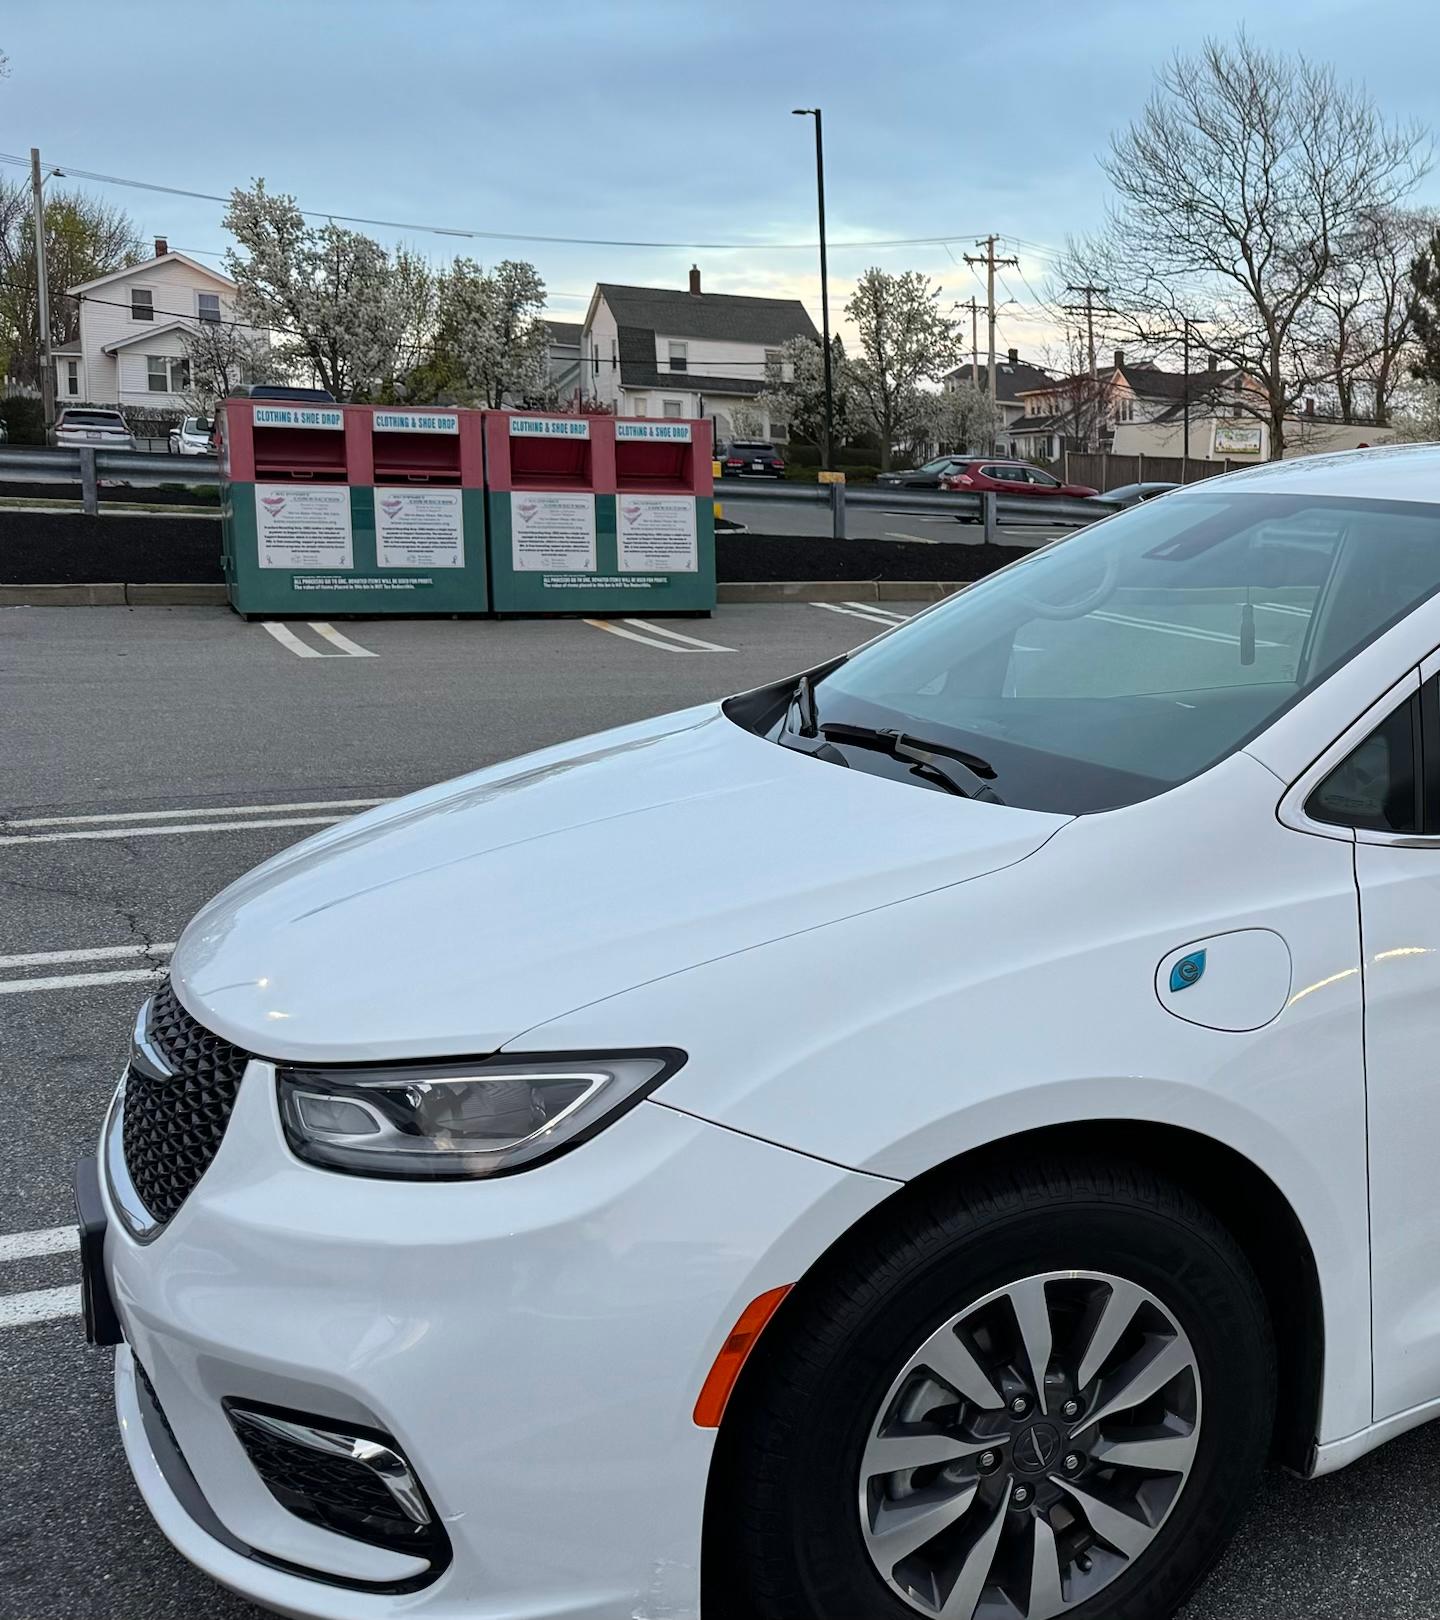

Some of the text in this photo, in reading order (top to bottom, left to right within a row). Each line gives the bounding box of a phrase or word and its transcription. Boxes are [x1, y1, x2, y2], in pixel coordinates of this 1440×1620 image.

[257, 410, 340, 424] CLOTHING & SHOE DROP
[377, 416, 455, 429] CLOTHING & SHOE DROP
[513, 421, 586, 434] CLOTHING & SHOE DROP
[618, 426, 688, 438] CLOTHING & SHOE DROP
